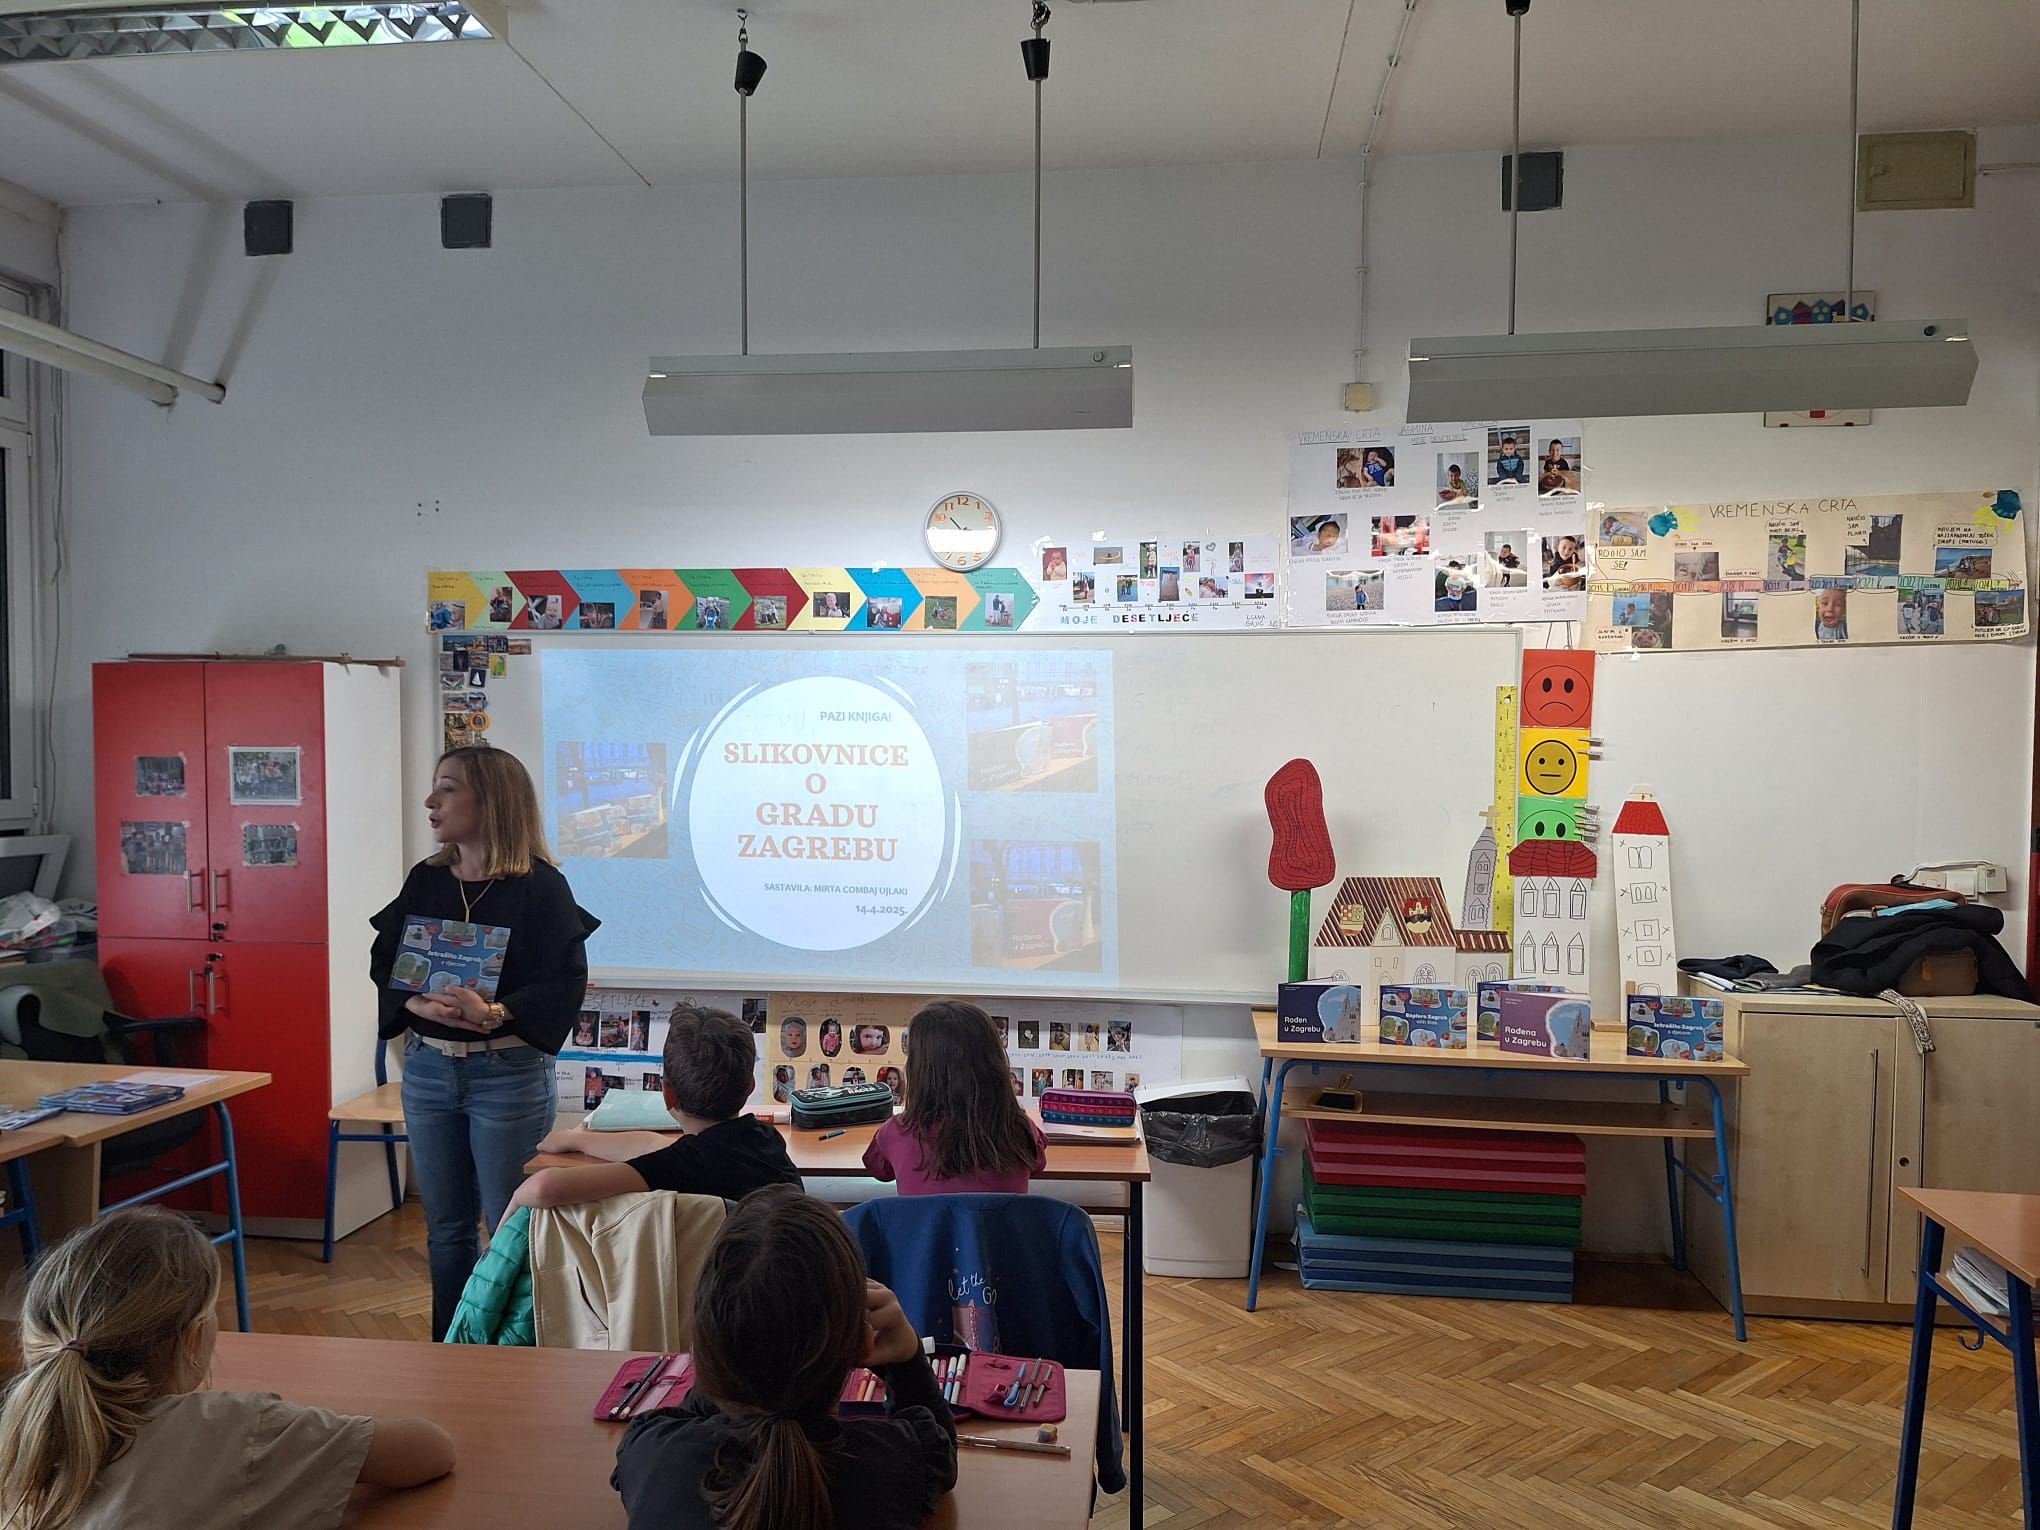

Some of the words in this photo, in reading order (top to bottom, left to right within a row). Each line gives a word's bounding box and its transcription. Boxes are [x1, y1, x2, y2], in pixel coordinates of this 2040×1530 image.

[1298, 429, 1349, 442] VREMENSKA
[1355, 427, 1381, 440] CRTA
[957, 496, 969, 506] 12
[975, 501, 981, 510] 1
[1709, 502, 1809, 518] VREMENSKA
[1818, 498, 1858, 513] CRTA
[957, 554, 967, 565] 6
[1060, 614, 1098, 625] MOJE
[1113, 610, 1200, 624] DESETLJEĆE
[820, 710, 847, 721] PAZI
[848, 711, 892, 724] KNJIGA!
[723, 742, 909, 768] SLIKOVNICE
[805, 772, 827, 795] O
[755, 801, 879, 829] GRADU
[737, 834, 898, 863] ZAGREBU
[764, 882, 813, 892] SASTAVILA:
[813, 884, 841, 894] MIRTA
[879, 887, 908, 897] UJLAKI
[855, 904, 909, 917] 14.4.2025.
[1290, 1025, 1321, 1034] Zagrebu
[1504, 1025, 1537, 1037] Rođena
[1511, 1036, 1547, 1048] Zagrebu
[970, 1271, 986, 1287] the
